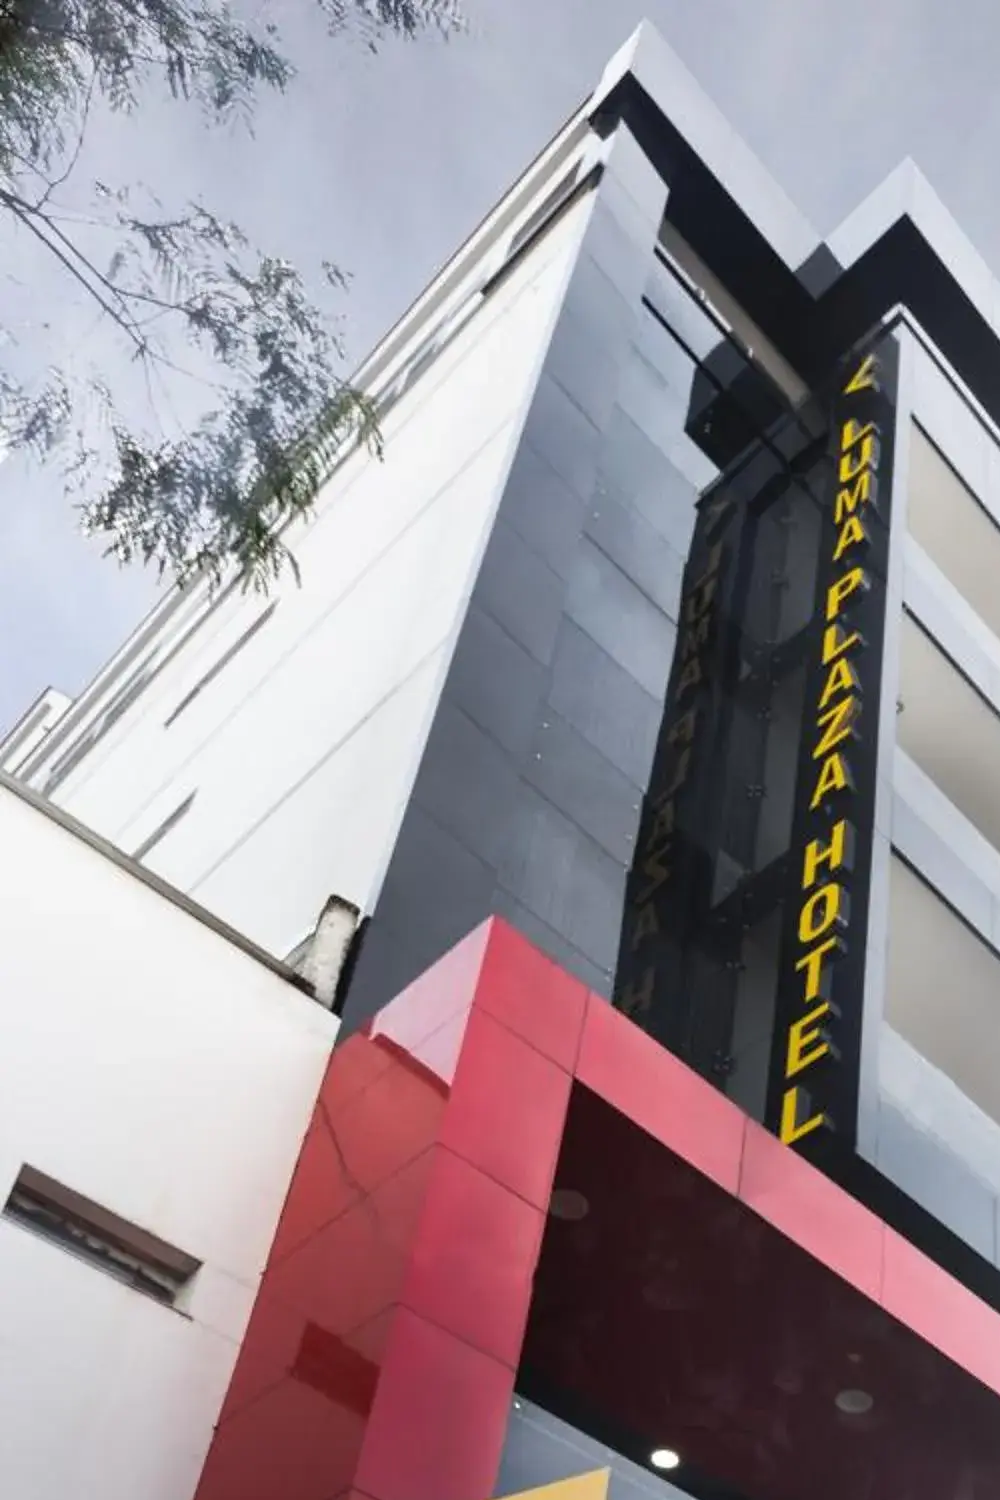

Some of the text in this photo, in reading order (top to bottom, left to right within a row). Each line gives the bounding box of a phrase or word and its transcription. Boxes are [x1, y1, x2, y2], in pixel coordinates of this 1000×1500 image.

[780, 418, 874, 1145] LUMA PLAZA HOTEL
